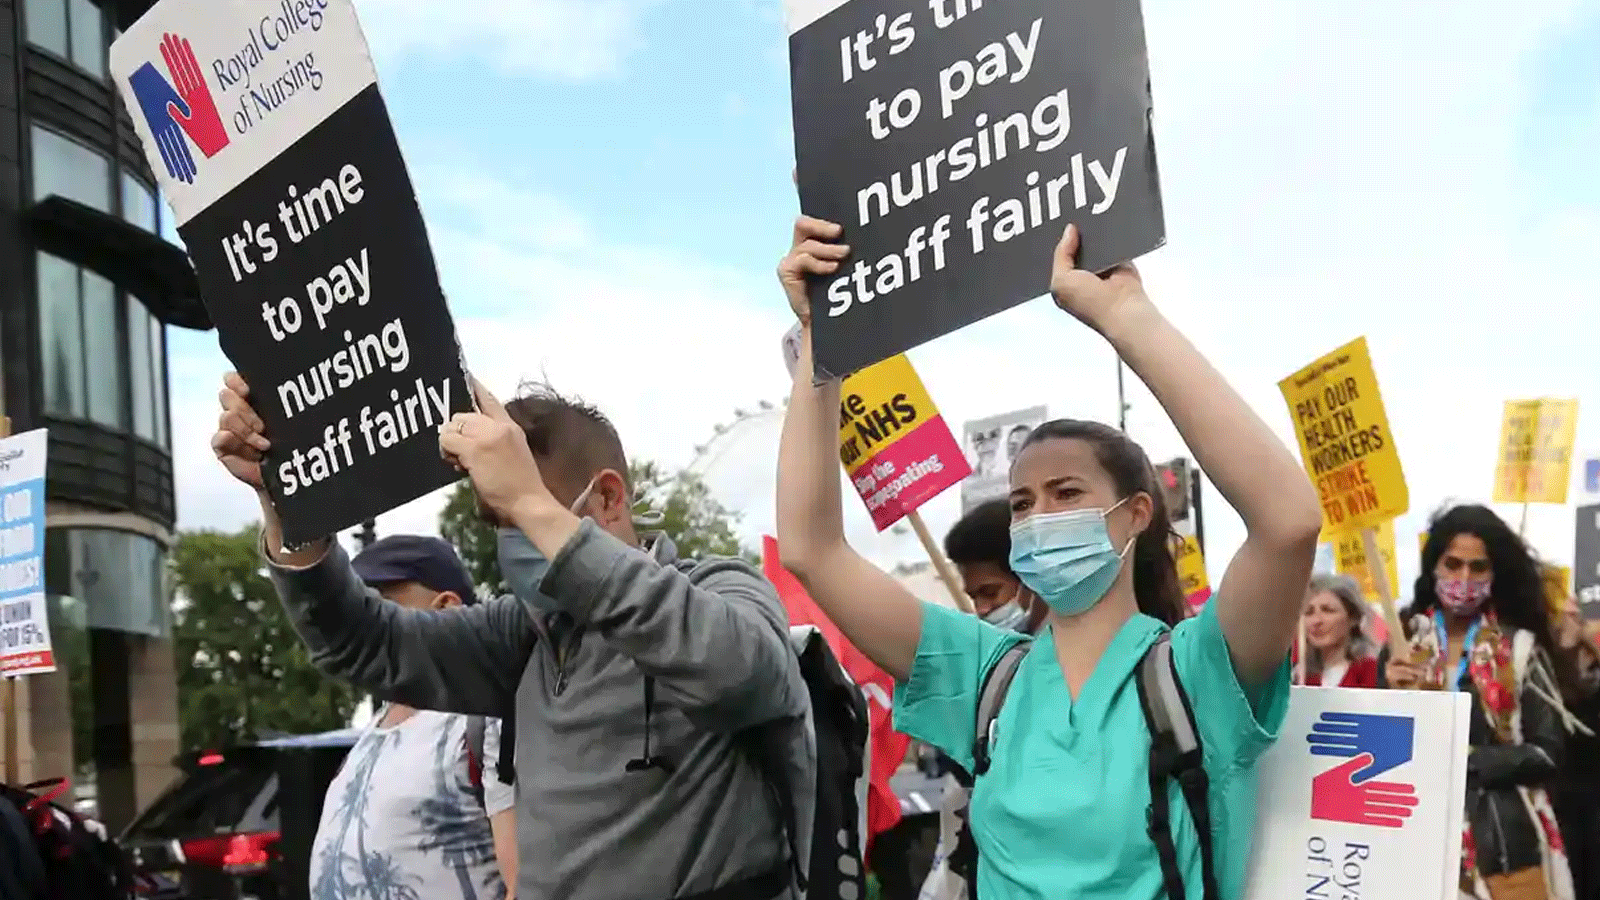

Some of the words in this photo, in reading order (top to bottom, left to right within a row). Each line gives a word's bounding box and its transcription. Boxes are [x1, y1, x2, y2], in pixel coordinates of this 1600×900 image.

[212, 27, 265, 92] Royal
[840, 12, 916, 84] It's
[232, 93, 252, 136] of
[250, 51, 324, 121] Nursing
[865, 87, 922, 141] to
[939, 17, 1043, 121] pay
[857, 87, 1072, 227] nursing
[221, 219, 279, 283] It's
[278, 163, 365, 245] time
[827, 213, 952, 318] staff
[966, 146, 1128, 255] fairly
[262, 297, 302, 342] to
[306, 247, 371, 330] pay
[277, 317, 411, 419] nursing
[840, 393, 867, 430] ke
[854, 392, 917, 450] NHS
[1295, 395, 1322, 426] PAY
[1323, 376, 1360, 411] OUR
[1303, 406, 1359, 451] HEALTH
[278, 417, 355, 496] staff
[359, 376, 451, 456] fairly
[1310, 423, 1384, 476] WORKERS
[1317, 459, 1371, 502] STRIKE
[1323, 498, 1345, 526] TO
[1345, 485, 1380, 518] WIN
[1307, 836, 1334, 868] of
[1333, 842, 1370, 900] Roy
[1305, 873, 1331, 900] N
